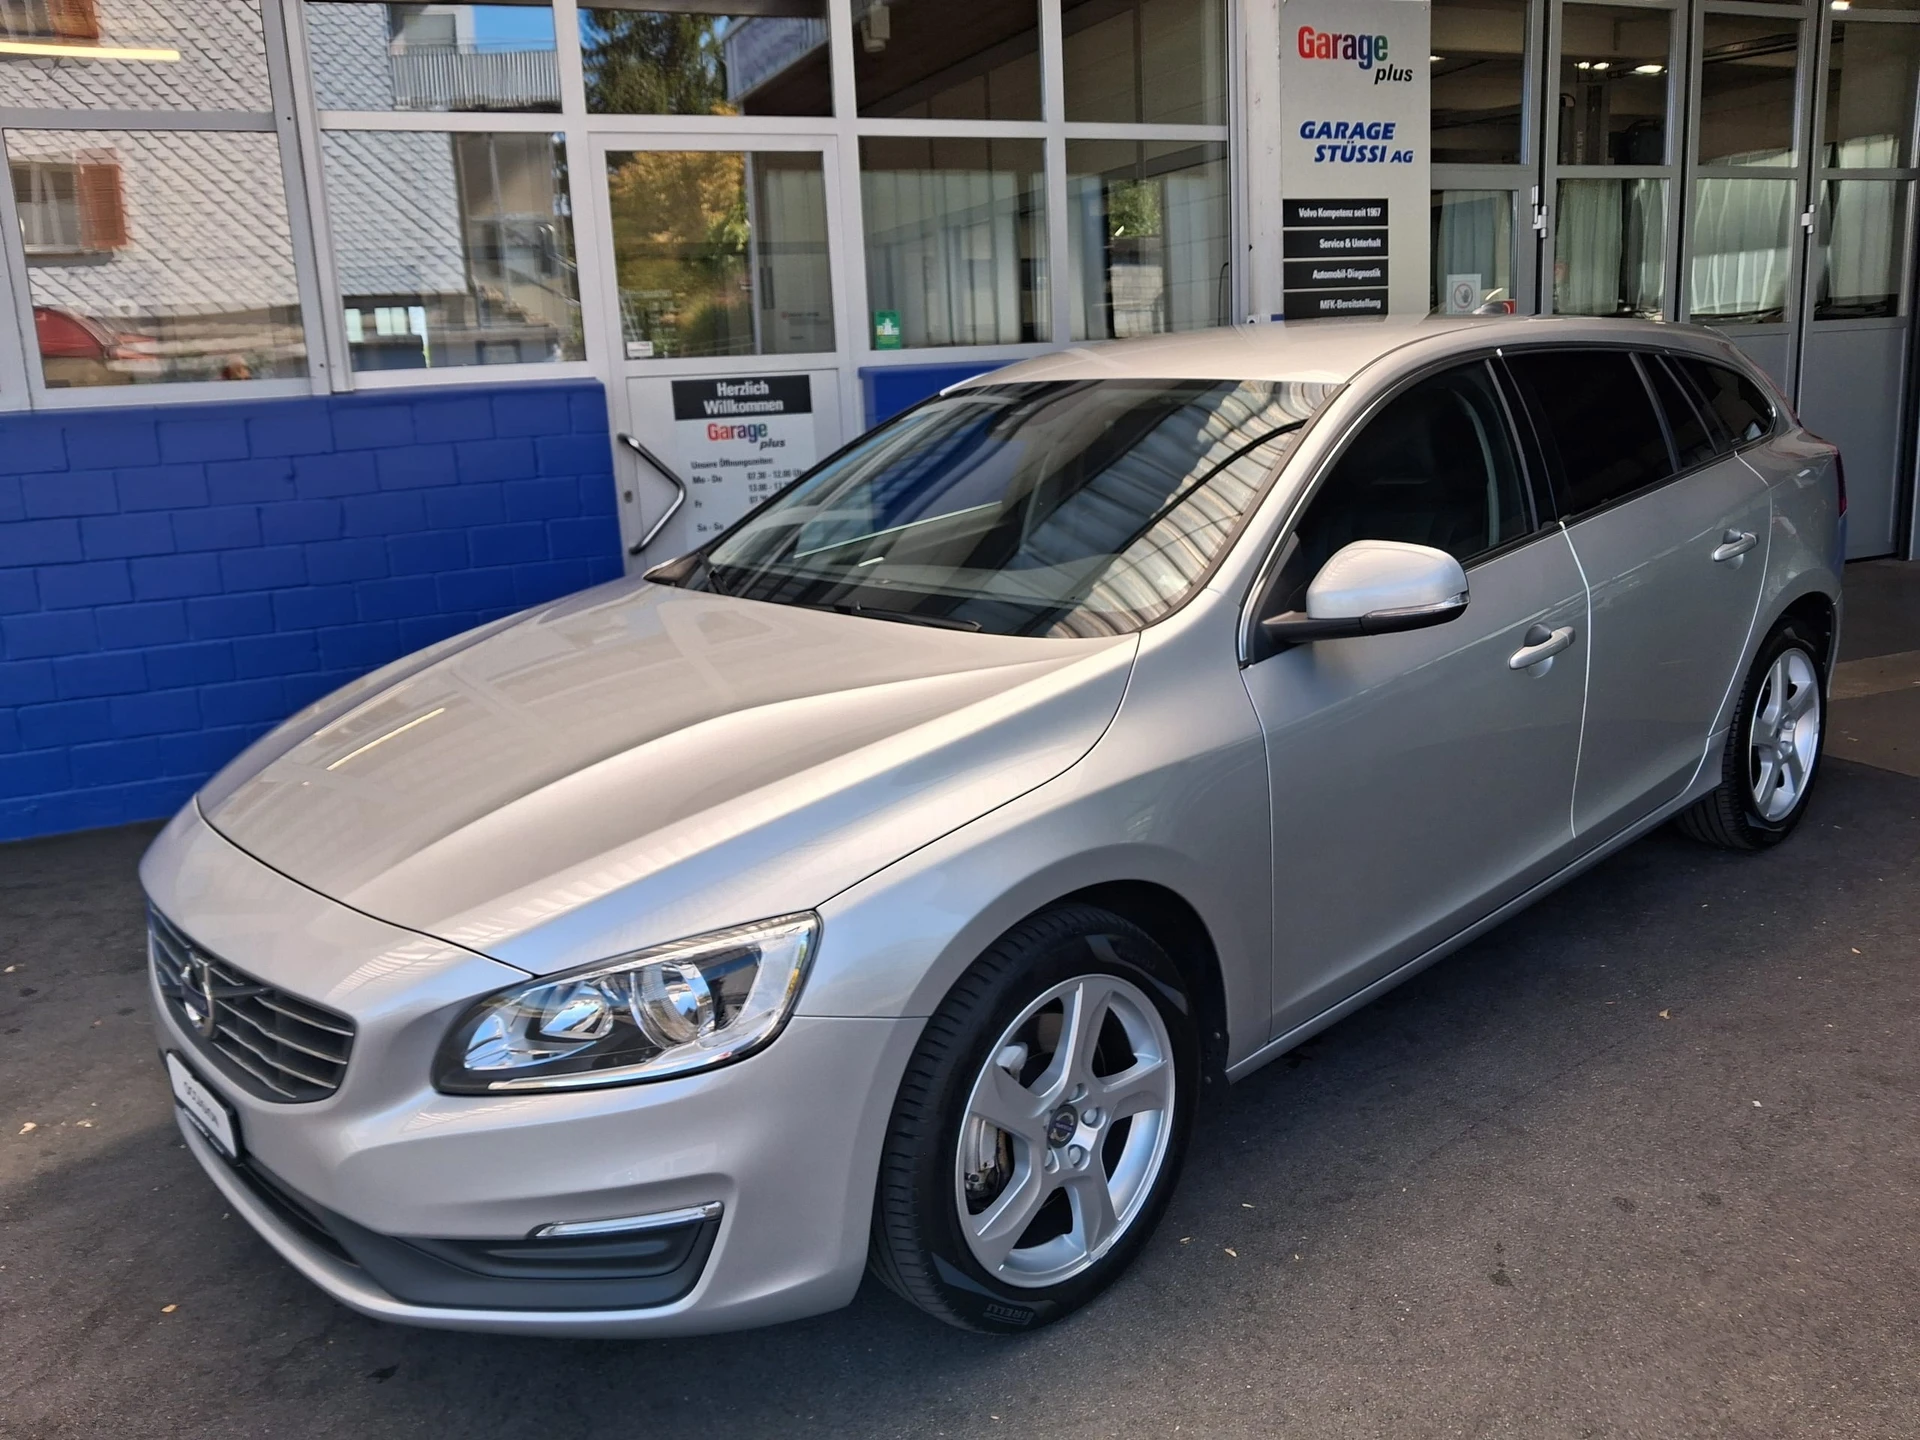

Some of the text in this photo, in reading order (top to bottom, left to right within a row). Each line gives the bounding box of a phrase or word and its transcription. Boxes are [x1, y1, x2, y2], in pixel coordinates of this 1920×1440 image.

[1297, 26, 1389, 70] Garage
[1374, 63, 1413, 85] plus
[1299, 121, 1396, 140] GARAGE
[1314, 140, 1414, 163] STÜSSI AG
[1298, 207, 1317, 218] Volvo
[1318, 207, 1353, 220] Kompetenz
[1354, 207, 1366, 217] seit
[1319, 237, 1381, 249] Service & Unterhalt
[1312, 268, 1381, 280] Automobil-Diagnostik
[716, 380, 770, 397] Herzlich
[703, 399, 784, 415] Willkommen
[707, 422, 768, 443] Garage
[759, 438, 786, 451] plus
